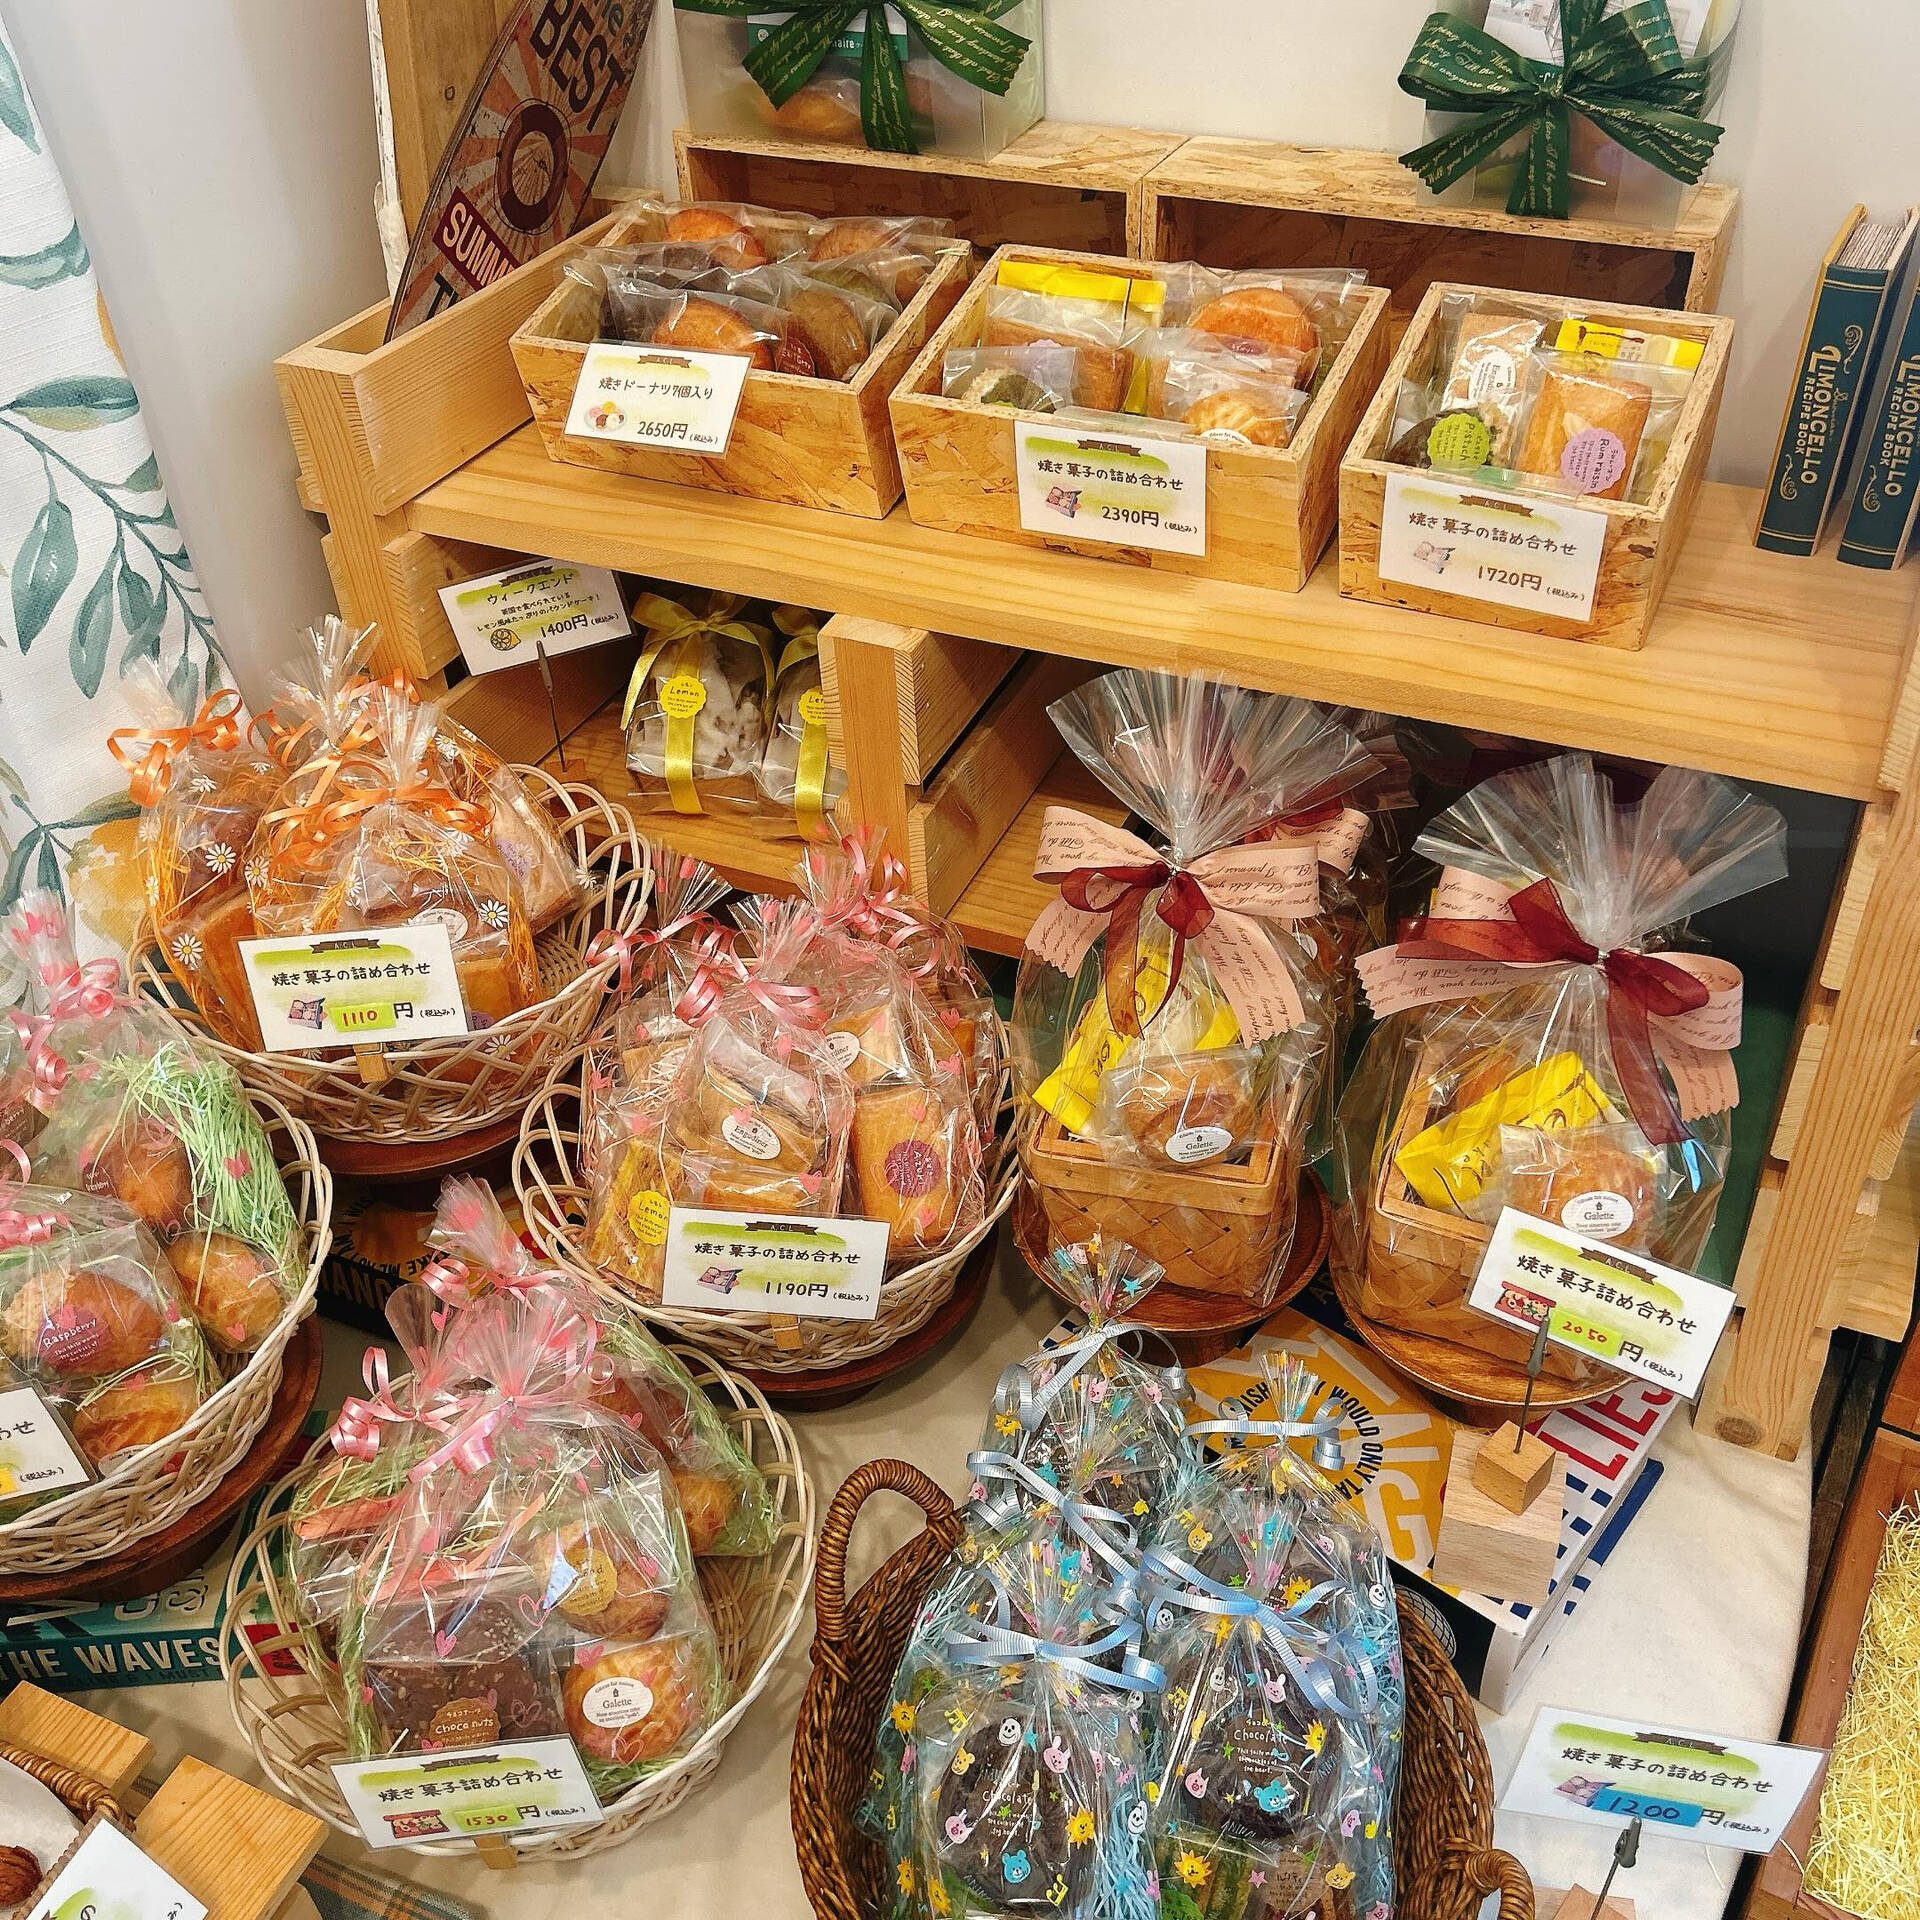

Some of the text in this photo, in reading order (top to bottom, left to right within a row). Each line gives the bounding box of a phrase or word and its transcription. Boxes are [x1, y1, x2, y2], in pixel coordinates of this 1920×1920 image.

[530, 0, 626, 133] BEST
[599, 377, 713, 400] 焼きドーナツ7個入り
[1794, 376, 1815, 455] RECIPE BOOK
[1800, 345, 1842, 485] LIMONCELLO
[1879, 387, 1903, 466] RECIPE BOOK
[637, 421, 688, 440] 2650円
[1037, 459, 1183, 490] 焼き菓子の詰め合わせ
[1590, 439, 1609, 488] Rum raisin
[1101, 506, 1160, 527] 2390円
[1408, 512, 1577, 556] 焼き菓子の詰め合わせ
[487, 573, 575, 605] ウィークエンド
[1478, 565, 1542, 591] 1720円
[501, 592, 571, 615] 英国で食べられている
[540, 614, 588, 638] 1400円
[669, 686, 700, 697] Lemon
[1231, 882, 1253, 891] hold
[1255, 882, 1285, 895] And
[272, 962, 431, 986] 焼き菓子の詰め合わせ
[343, 1010, 378, 1027] 1110
[394, 1002, 413, 1019] 円
[1185, 1141, 1213, 1150] Galette
[770, 1224, 794, 1232] ACL
[1584, 1211, 1614, 1221] Galette
[695, 1243, 861, 1264] 焼き菓子の詰め合わせ
[765, 1282, 828, 1298] 1190円
[1517, 1255, 1697, 1335] 焼き菓子詰め合わせ
[43, 1317, 97, 1348] Raspberry
[1619, 1340, 1644, 1363] 円
[1330, 1385, 1380, 1437] WOULD
[1361, 1442, 1384, 1485] ONLY
[74, 1637, 220, 1675] WAVES
[603, 1698, 632, 1709] Galette
[435, 1718, 494, 1734] choco nuts
[1560, 1747, 1773, 1794] 焼き菓子の詰め合わせ
[378, 1768, 563, 1803] 焼き菓子詰め合わせ
[465, 1813, 508, 1826] 1530
[516, 1804, 541, 1820] 円
[1606, 1796, 1680, 1820] 1200
[1700, 1808, 1726, 1827] 円
